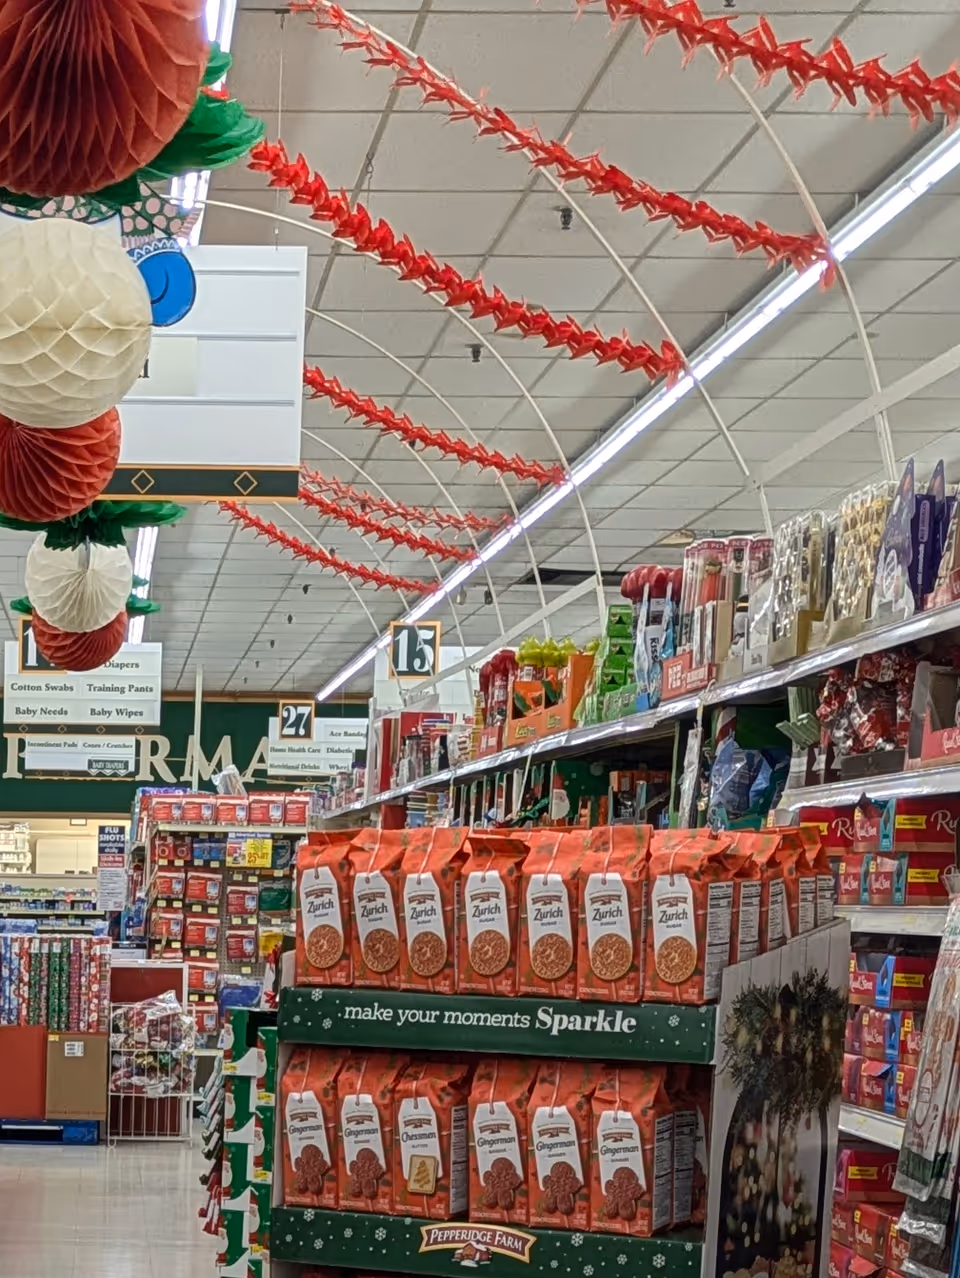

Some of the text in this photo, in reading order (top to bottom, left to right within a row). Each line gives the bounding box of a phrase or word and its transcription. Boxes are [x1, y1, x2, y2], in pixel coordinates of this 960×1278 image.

[394, 629, 435, 673] 15
[103, 660, 140, 671] Diapers
[10, 682, 74, 692] Cotton Swabs
[87, 683, 154, 695] Training Pants
[15, 706, 68, 717] Baby Needs
[90, 708, 144, 719] Baby Wipes
[281, 705, 312, 736] 27
[92, 761, 105, 769] BABY
[104, 826, 119, 834] FLU
[99, 834, 125, 842] SHOTS
[306, 898, 335, 915] Zurich
[360, 902, 389, 919] Zurich
[410, 905, 437, 920] Zurich
[471, 903, 501, 918] Zurich
[533, 907, 563, 921] Zurich
[591, 906, 623, 923] Zurich
[657, 909, 689, 924] Zurich
[343, 1002, 637, 1035] make your moments Sparkle
[288, 1124, 323, 1136] Gingerman
[344, 1127, 379, 1139] Gingerman
[401, 1131, 437, 1143] Chessmen
[477, 1136, 516, 1149] Gingerman
[535, 1139, 576, 1152] Gingerman
[599, 1145, 639, 1157] Gingerman
[430, 1228, 523, 1251] PEPPERIDGE FARM
